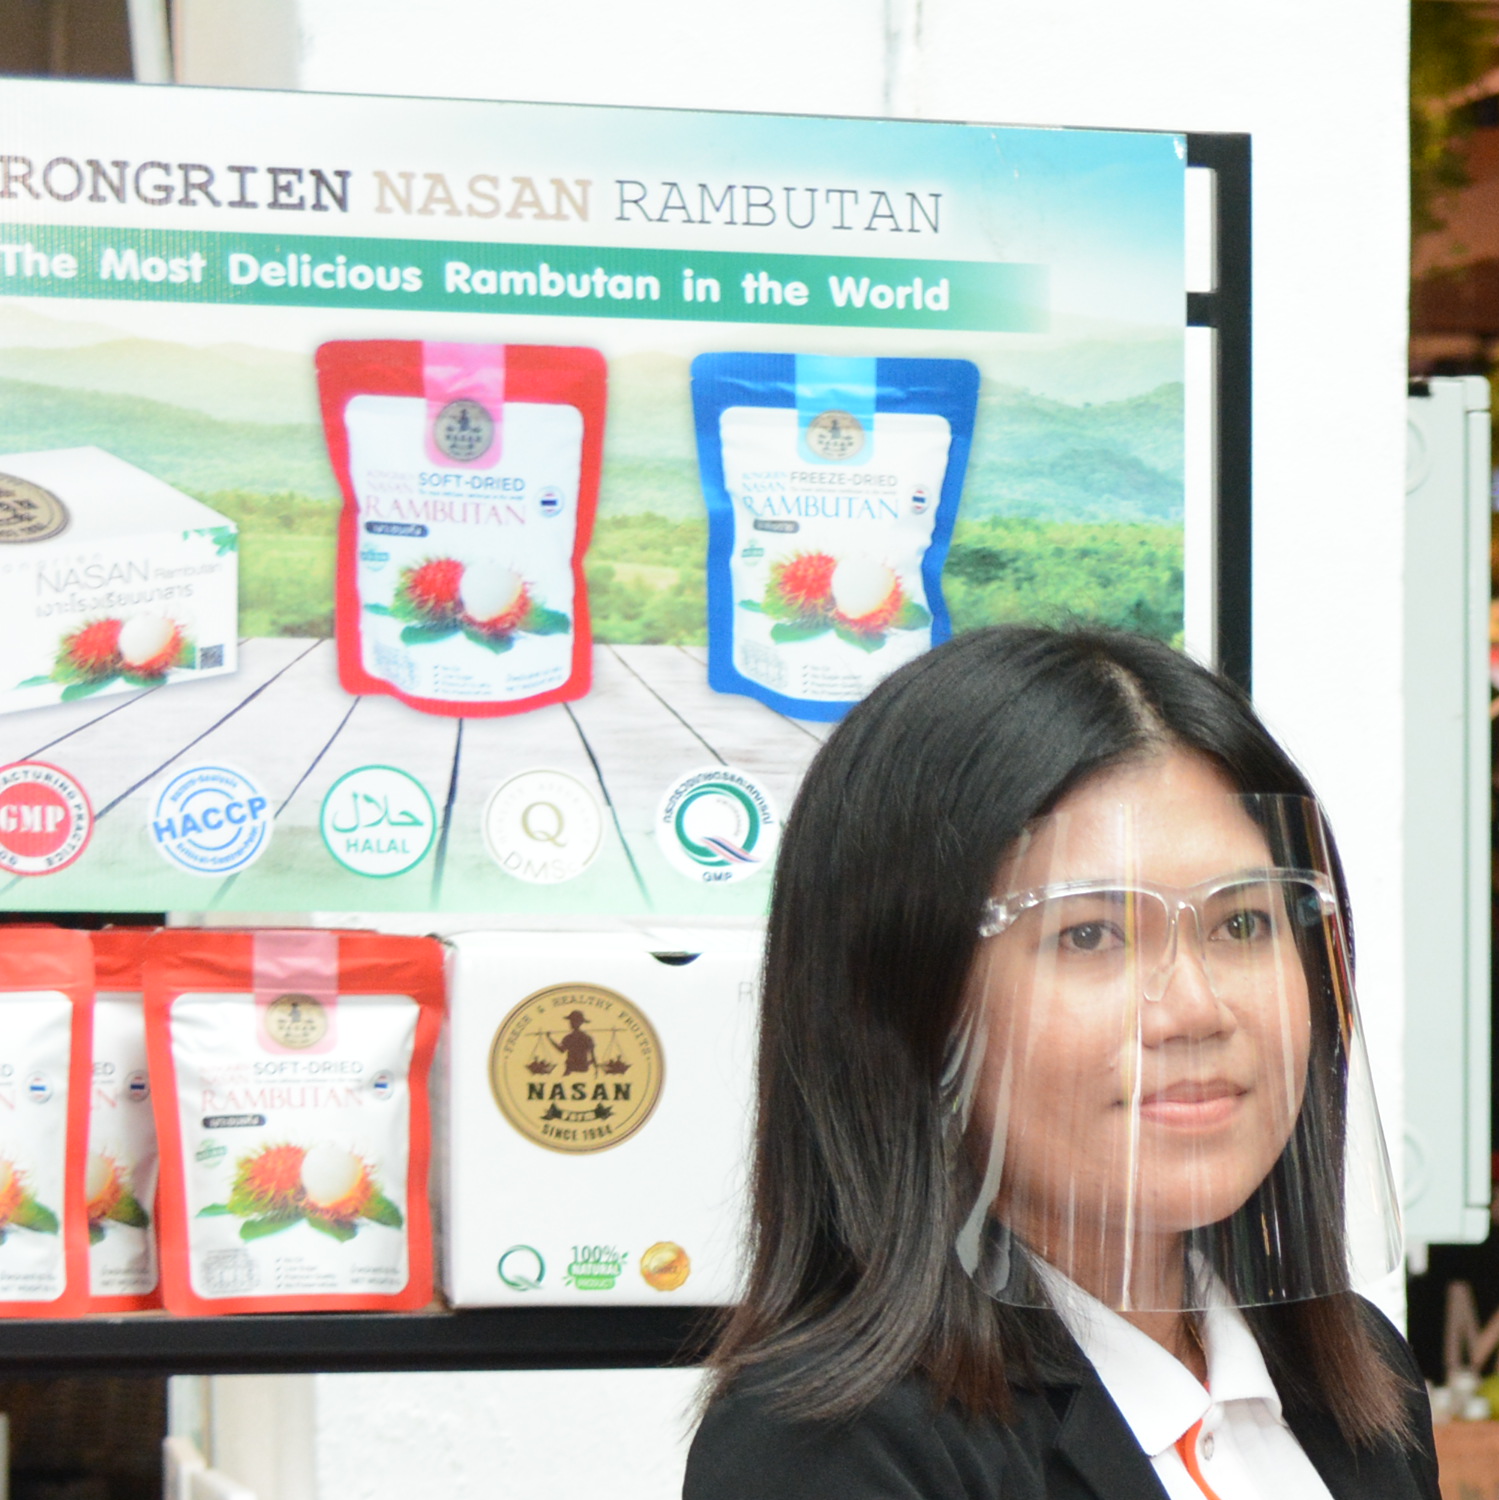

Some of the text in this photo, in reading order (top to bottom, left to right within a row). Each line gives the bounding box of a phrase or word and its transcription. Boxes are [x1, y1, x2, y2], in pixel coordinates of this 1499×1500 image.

[0, 155, 943, 234] RONGRIEN NASAN RAMBUTAN
[0, 243, 950, 312] The Most Delicious Rambutan in the World
[419, 472, 526, 492] SOFT-DRIED
[790, 471, 898, 487] FREEZE-DRIED
[365, 494, 527, 526] RAMBUTAN
[742, 494, 899, 520] RAMBUTAN
[36, 558, 150, 597] NASAN
[0, 804, 66, 834] GMP
[152, 796, 268, 843] HACCP
[346, 838, 411, 854] HALAL
[253, 1060, 364, 1076] SOFT-DRIED
[201, 1086, 364, 1112] RAMBUTAN
[526, 1082, 632, 1101] NASAN
[571, 1245, 619, 1264] 100%
